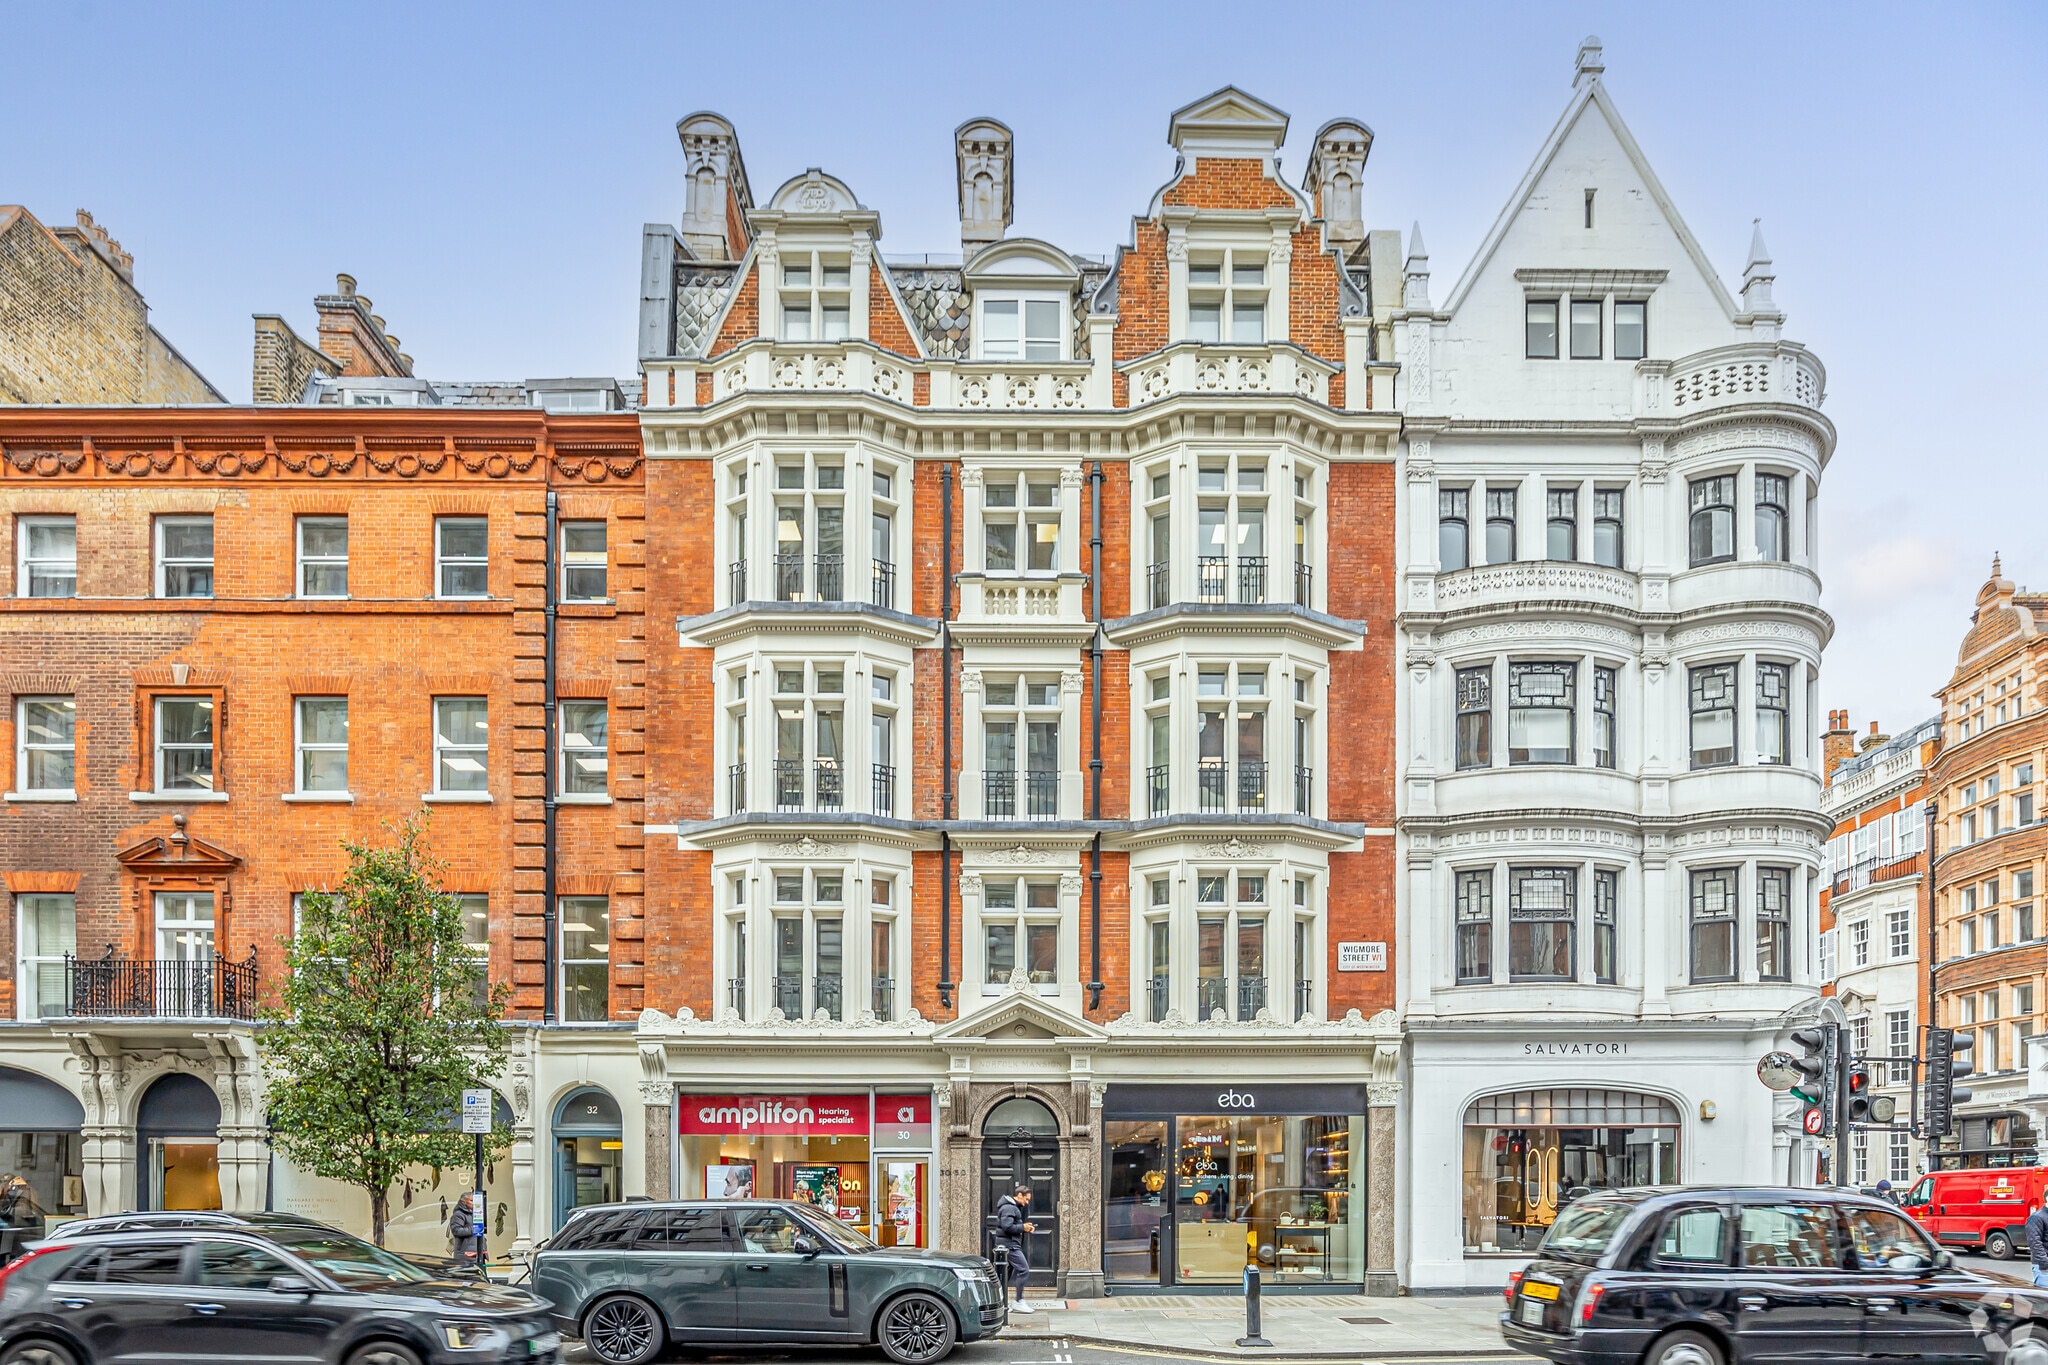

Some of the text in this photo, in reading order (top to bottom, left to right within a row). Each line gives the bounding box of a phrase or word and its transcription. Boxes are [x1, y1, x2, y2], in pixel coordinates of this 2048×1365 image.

[1343, 945, 1381, 953] WIGMORE
[1343, 954, 1370, 962] STREET
[1524, 1043, 1627, 1055] SALVATORI
[980, 1060, 1018, 1068] NORFOLK
[1217, 1088, 1255, 1108] eba
[586, 1105, 598, 1114] 32
[818, 1107, 850, 1117] Hearing
[699, 1101, 815, 1129] amplifon
[818, 1116, 855, 1125] specialist
[897, 1131, 910, 1140] 30
[1195, 1159, 1218, 1171] eba
